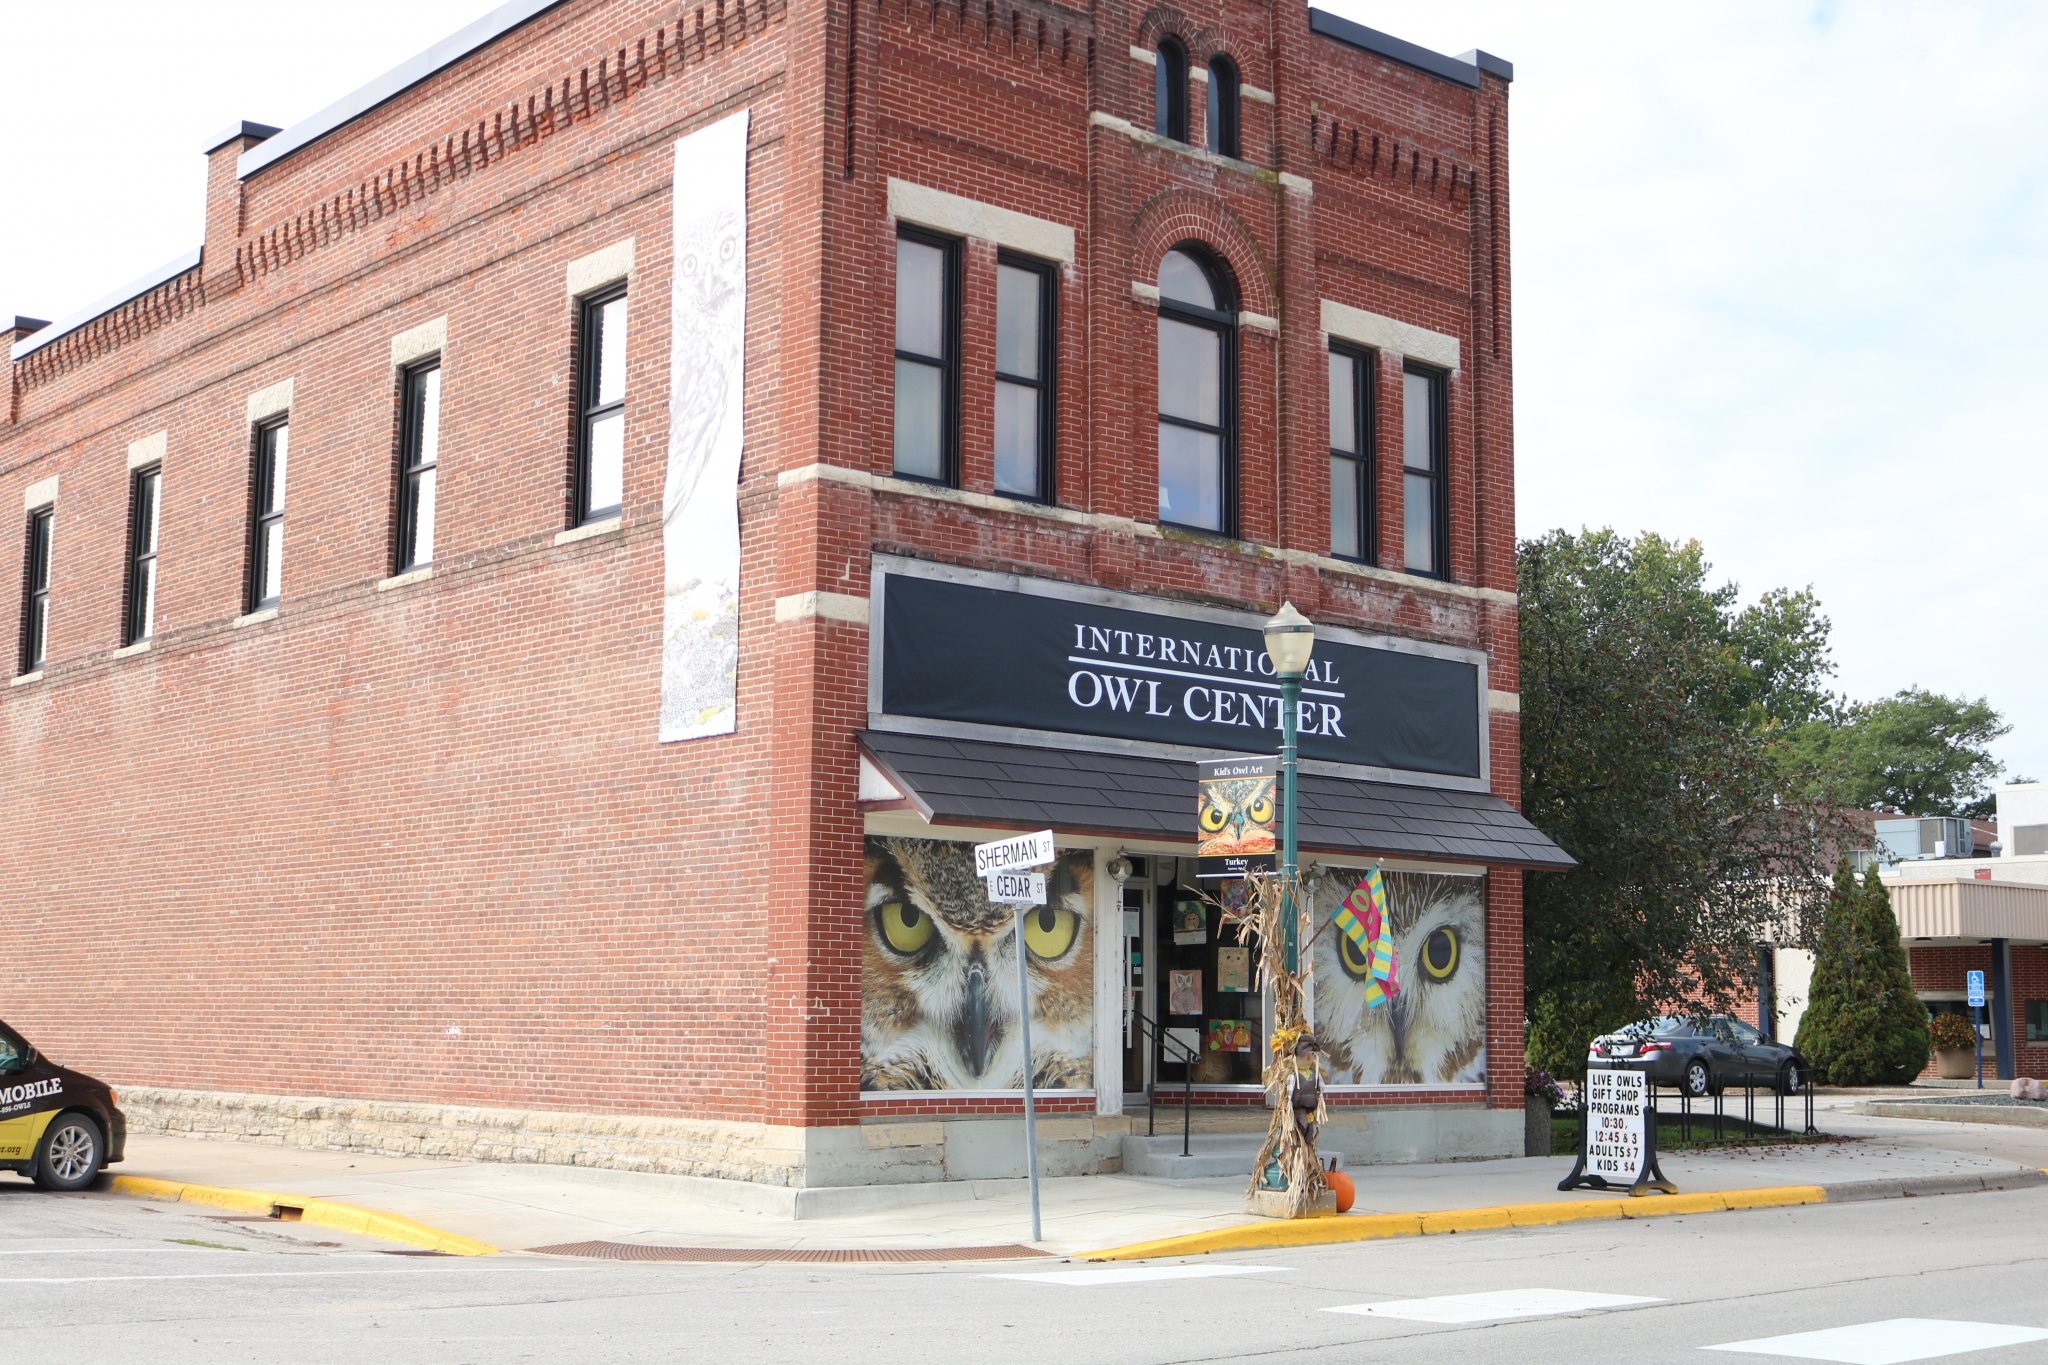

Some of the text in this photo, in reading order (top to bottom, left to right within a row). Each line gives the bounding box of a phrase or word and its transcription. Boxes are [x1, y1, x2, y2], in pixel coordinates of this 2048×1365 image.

[1074, 623, 1340, 684] INTERNATIOAL
[1068, 670, 1346, 738] OWL CENTER
[1214, 765, 1263, 776] Kid's Owl Art
[978, 839, 1051, 871] SHERMAN ST
[1224, 858, 1249, 867] Turkey
[996, 875, 1031, 898] CEDAR
[1036, 882, 1043, 894] ST
[1592, 1074, 1642, 1088] LIVE OWLS
[1592, 1088, 1639, 1102] GIFT SHOP
[1591, 1102, 1640, 1116] PROGRAMS
[1601, 1117, 1628, 1129] 10:30,
[1595, 1130, 1637, 1145] 12:45 & 3
[1597, 1159, 1636, 1173] KIDS $4
